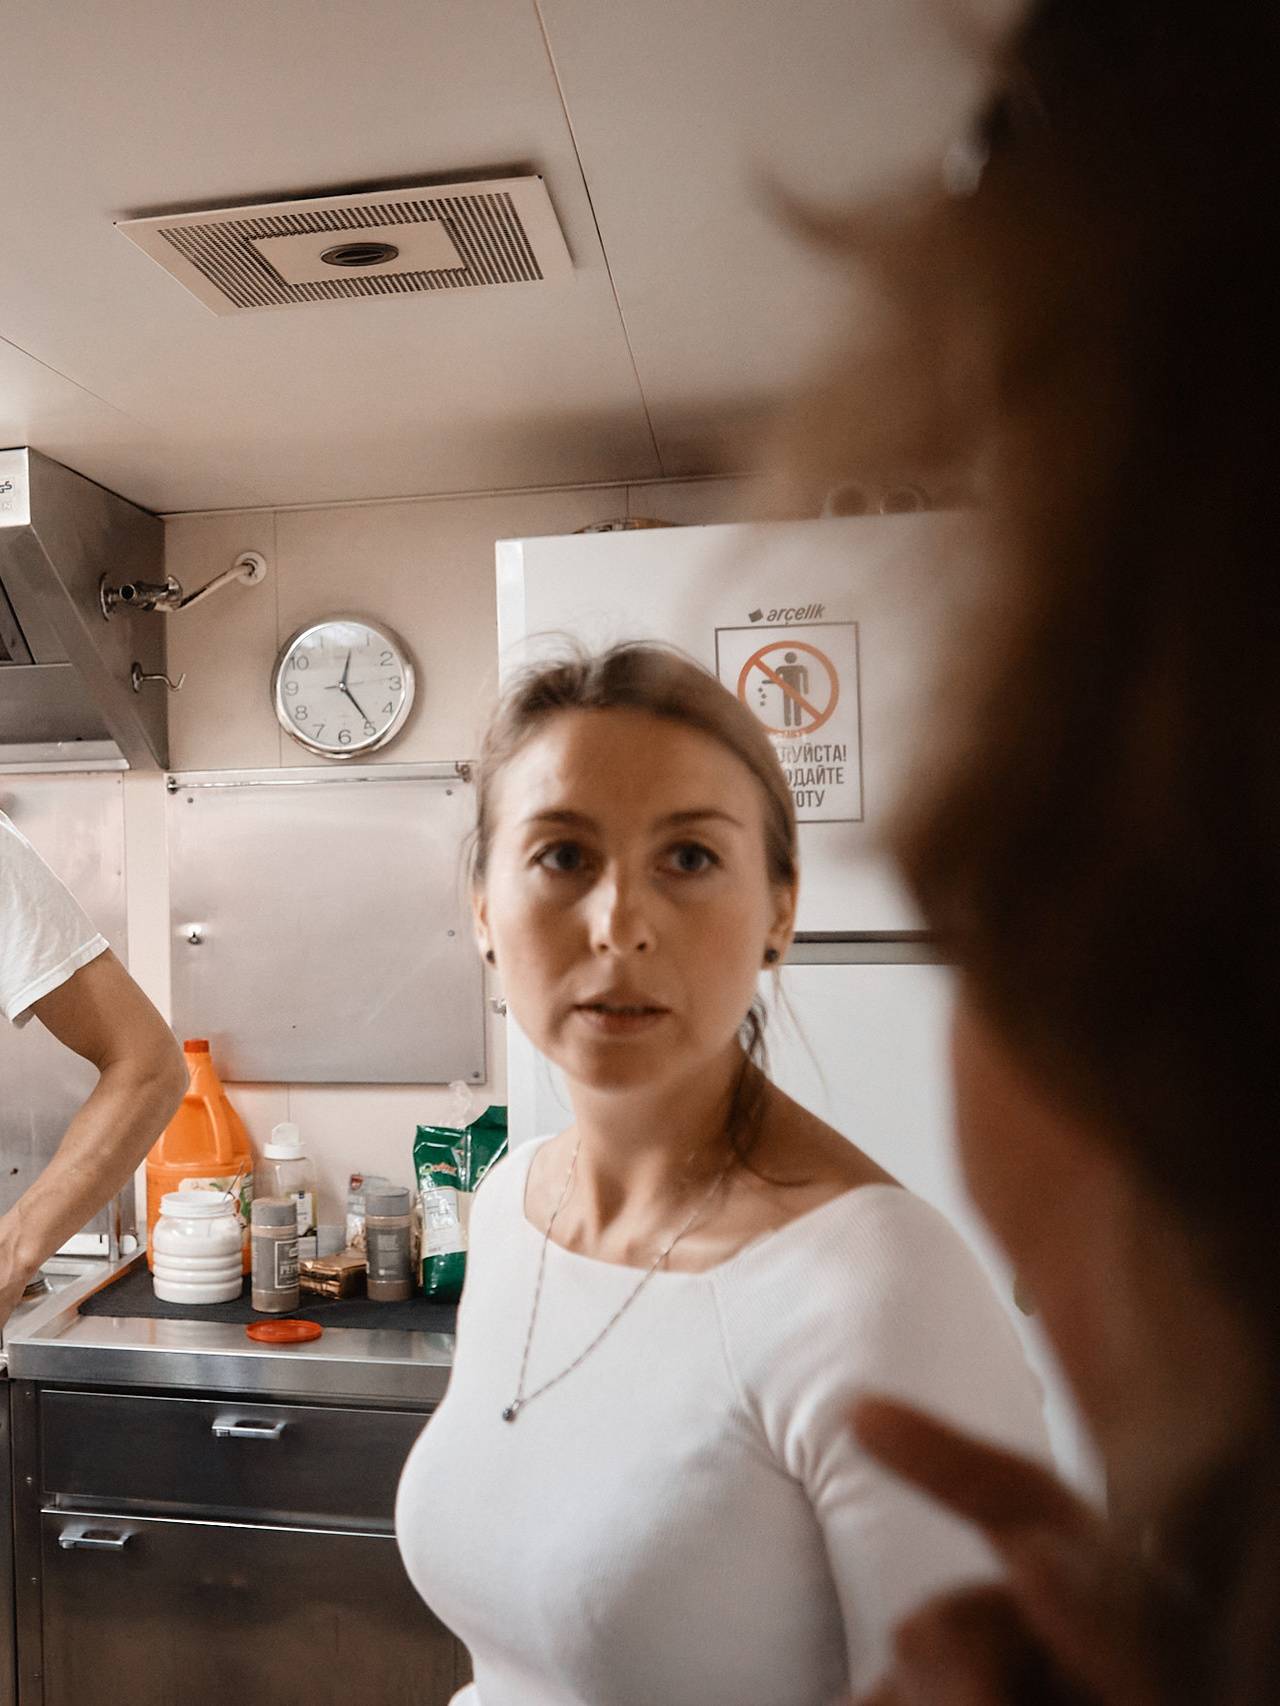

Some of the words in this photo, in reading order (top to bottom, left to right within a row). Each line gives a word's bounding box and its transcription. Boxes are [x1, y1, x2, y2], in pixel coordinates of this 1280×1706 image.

[290, 655, 309, 671] 10
[380, 650, 394, 667] 2
[285, 681, 299, 697] 9
[388, 675, 402, 692] 3
[294, 704, 308, 721] 8
[381, 701, 394, 715] 4
[312, 723, 325, 739] 7
[338, 728, 352, 745] 6
[363, 720, 377, 737] 5
[781, 743, 847, 763] ЛУЙСТА!
